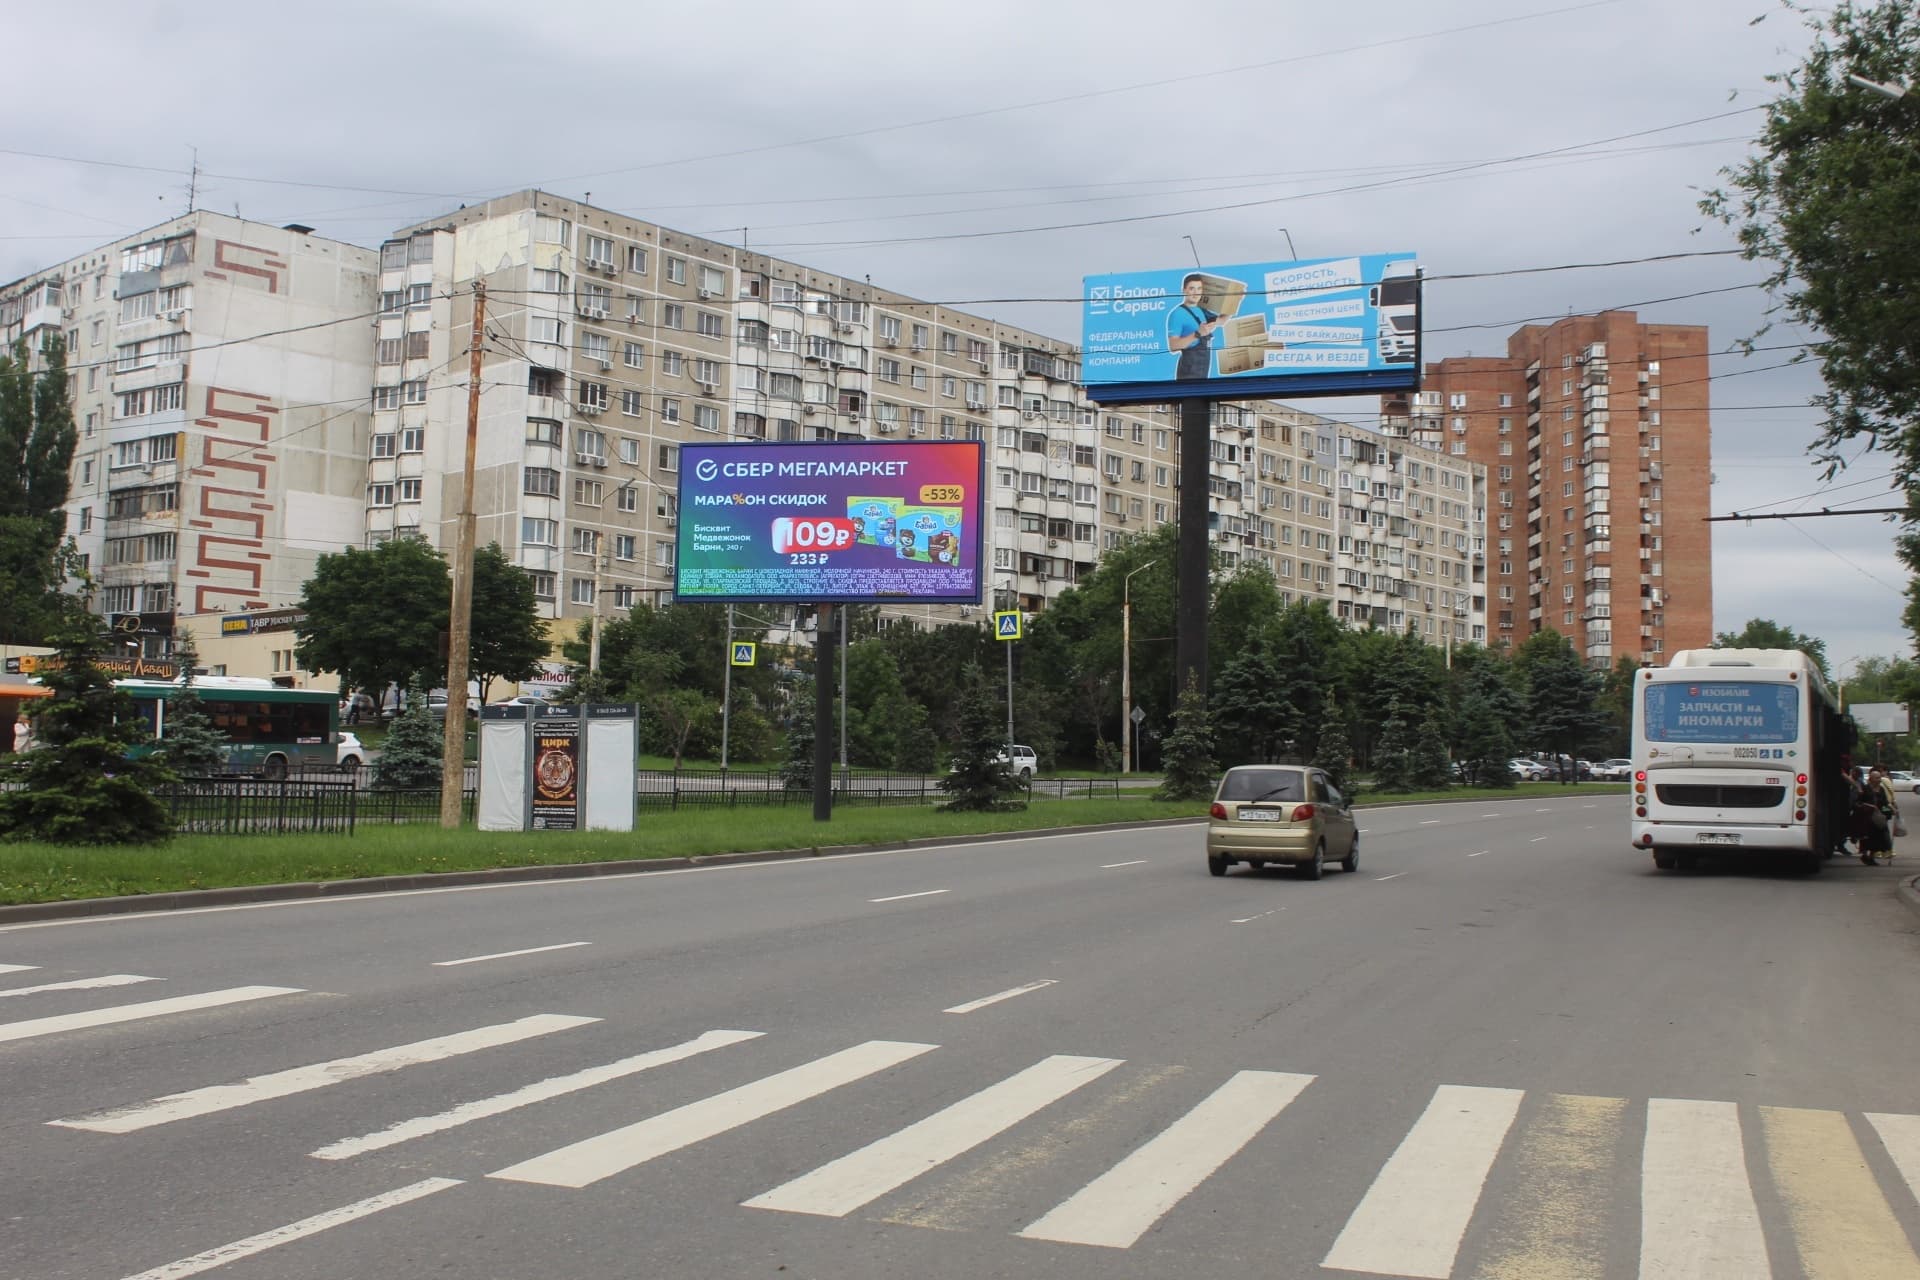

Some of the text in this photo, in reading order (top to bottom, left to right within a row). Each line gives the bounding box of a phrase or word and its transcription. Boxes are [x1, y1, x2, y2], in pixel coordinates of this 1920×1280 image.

[1272, 268, 1337, 286] СКОРОСТЬ,
[1113, 285, 1166, 299] Байкал
[1112, 300, 1166, 317] Сервис
[1277, 303, 1361, 320] ПО ЧЕСТНОЙ ЦЕНЕ
[1088, 329, 1154, 342] ФЕДЕРАЛЬНАЯ
[1271, 329, 1360, 341] ВЕЗИ С БАЙКАЛОМ
[1088, 342, 1160, 352] ТРАНСПОРТНАЯ
[1088, 355, 1141, 366] КОМПАНИЯ
[1268, 352, 1366, 363] ВСЕГДА И ВЕЗДЕ
[723, 461, 909, 477] СБЕР МЕГАМАРКЕТ
[694, 494, 828, 507] МАРА%ОН СКИДОК
[924, 488, 960, 501] -53%
[693, 524, 731, 533] Бисквит
[693, 533, 751, 543] Медвежонок
[693, 542, 724, 552] Барни,
[790, 553, 817, 565] 233
[1679, 702, 1742, 713] ЗАПЧАСТИ
[1678, 715, 1763, 727] ИНОМАРКИ
